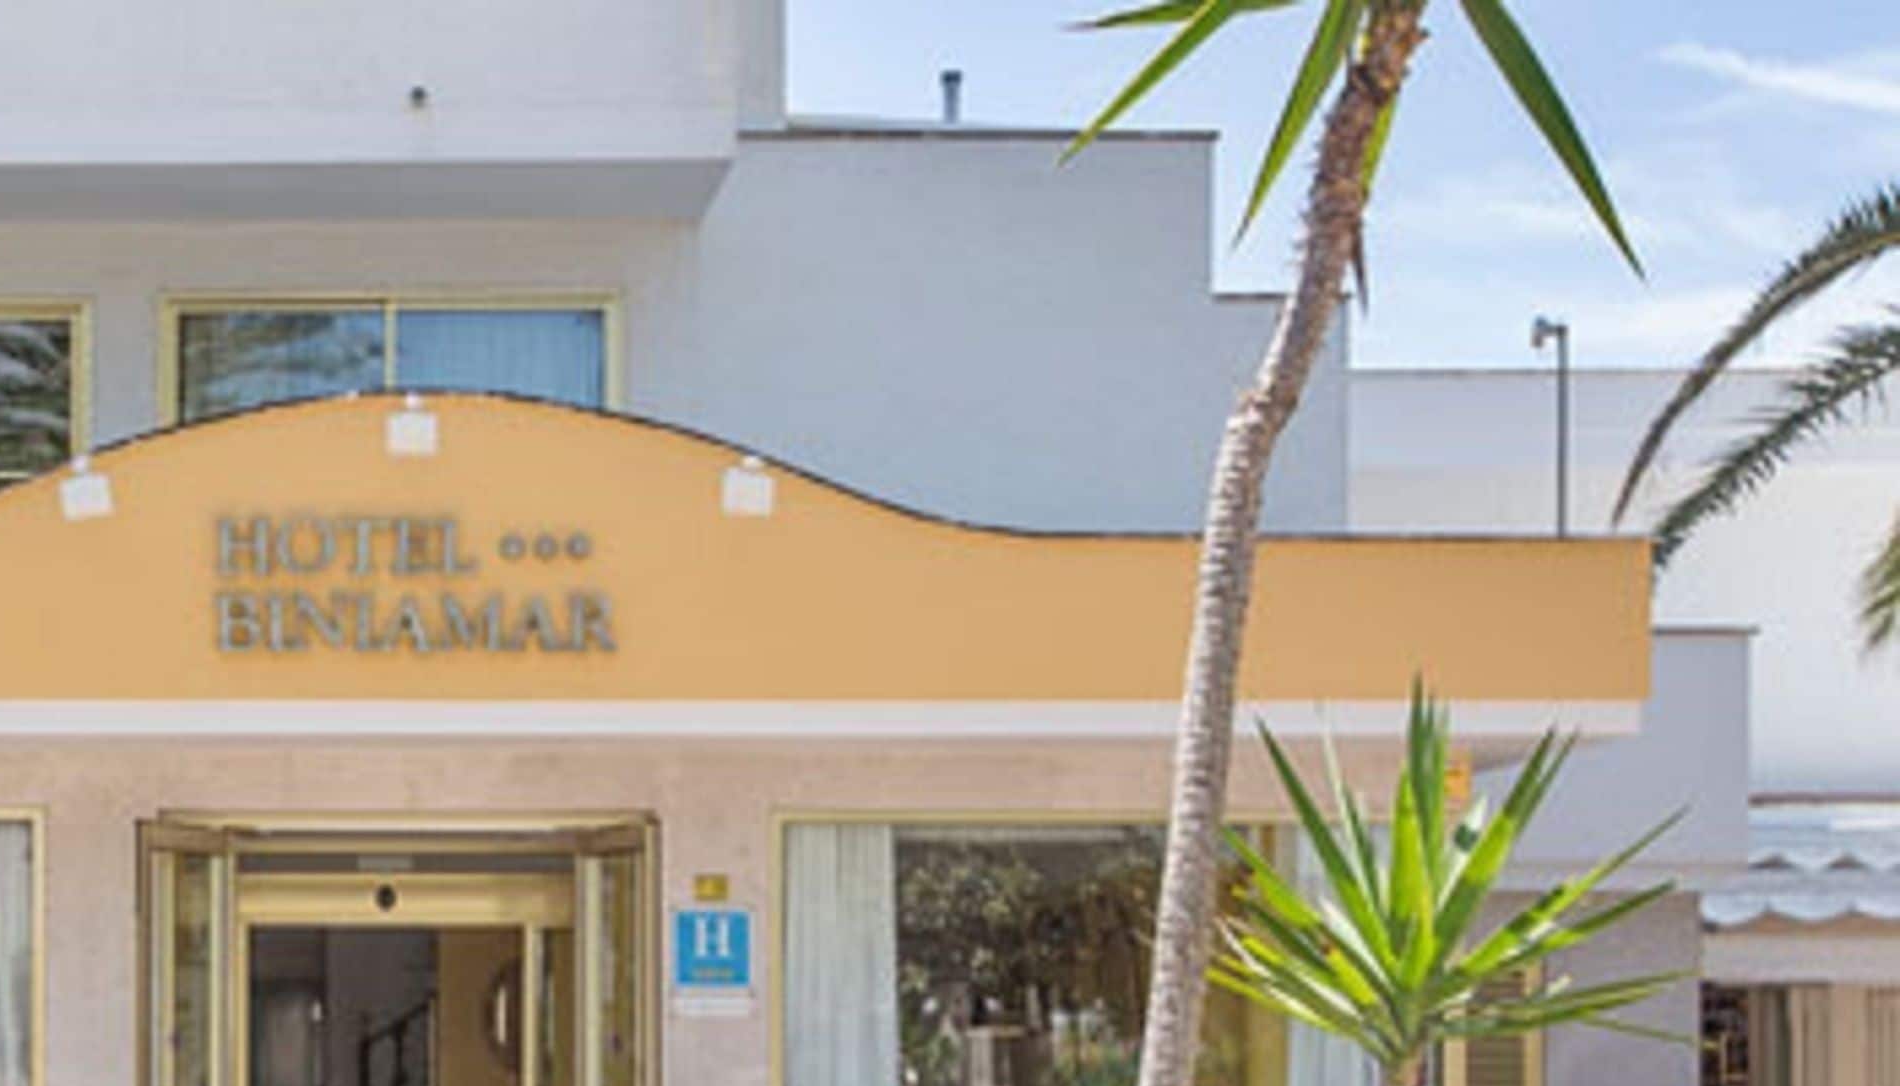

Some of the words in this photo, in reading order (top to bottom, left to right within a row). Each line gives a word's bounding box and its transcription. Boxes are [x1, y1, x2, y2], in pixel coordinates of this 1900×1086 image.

[214, 514, 479, 578] HOTEL
[214, 592, 618, 653] BINIAMAR
[694, 914, 731, 958] H
